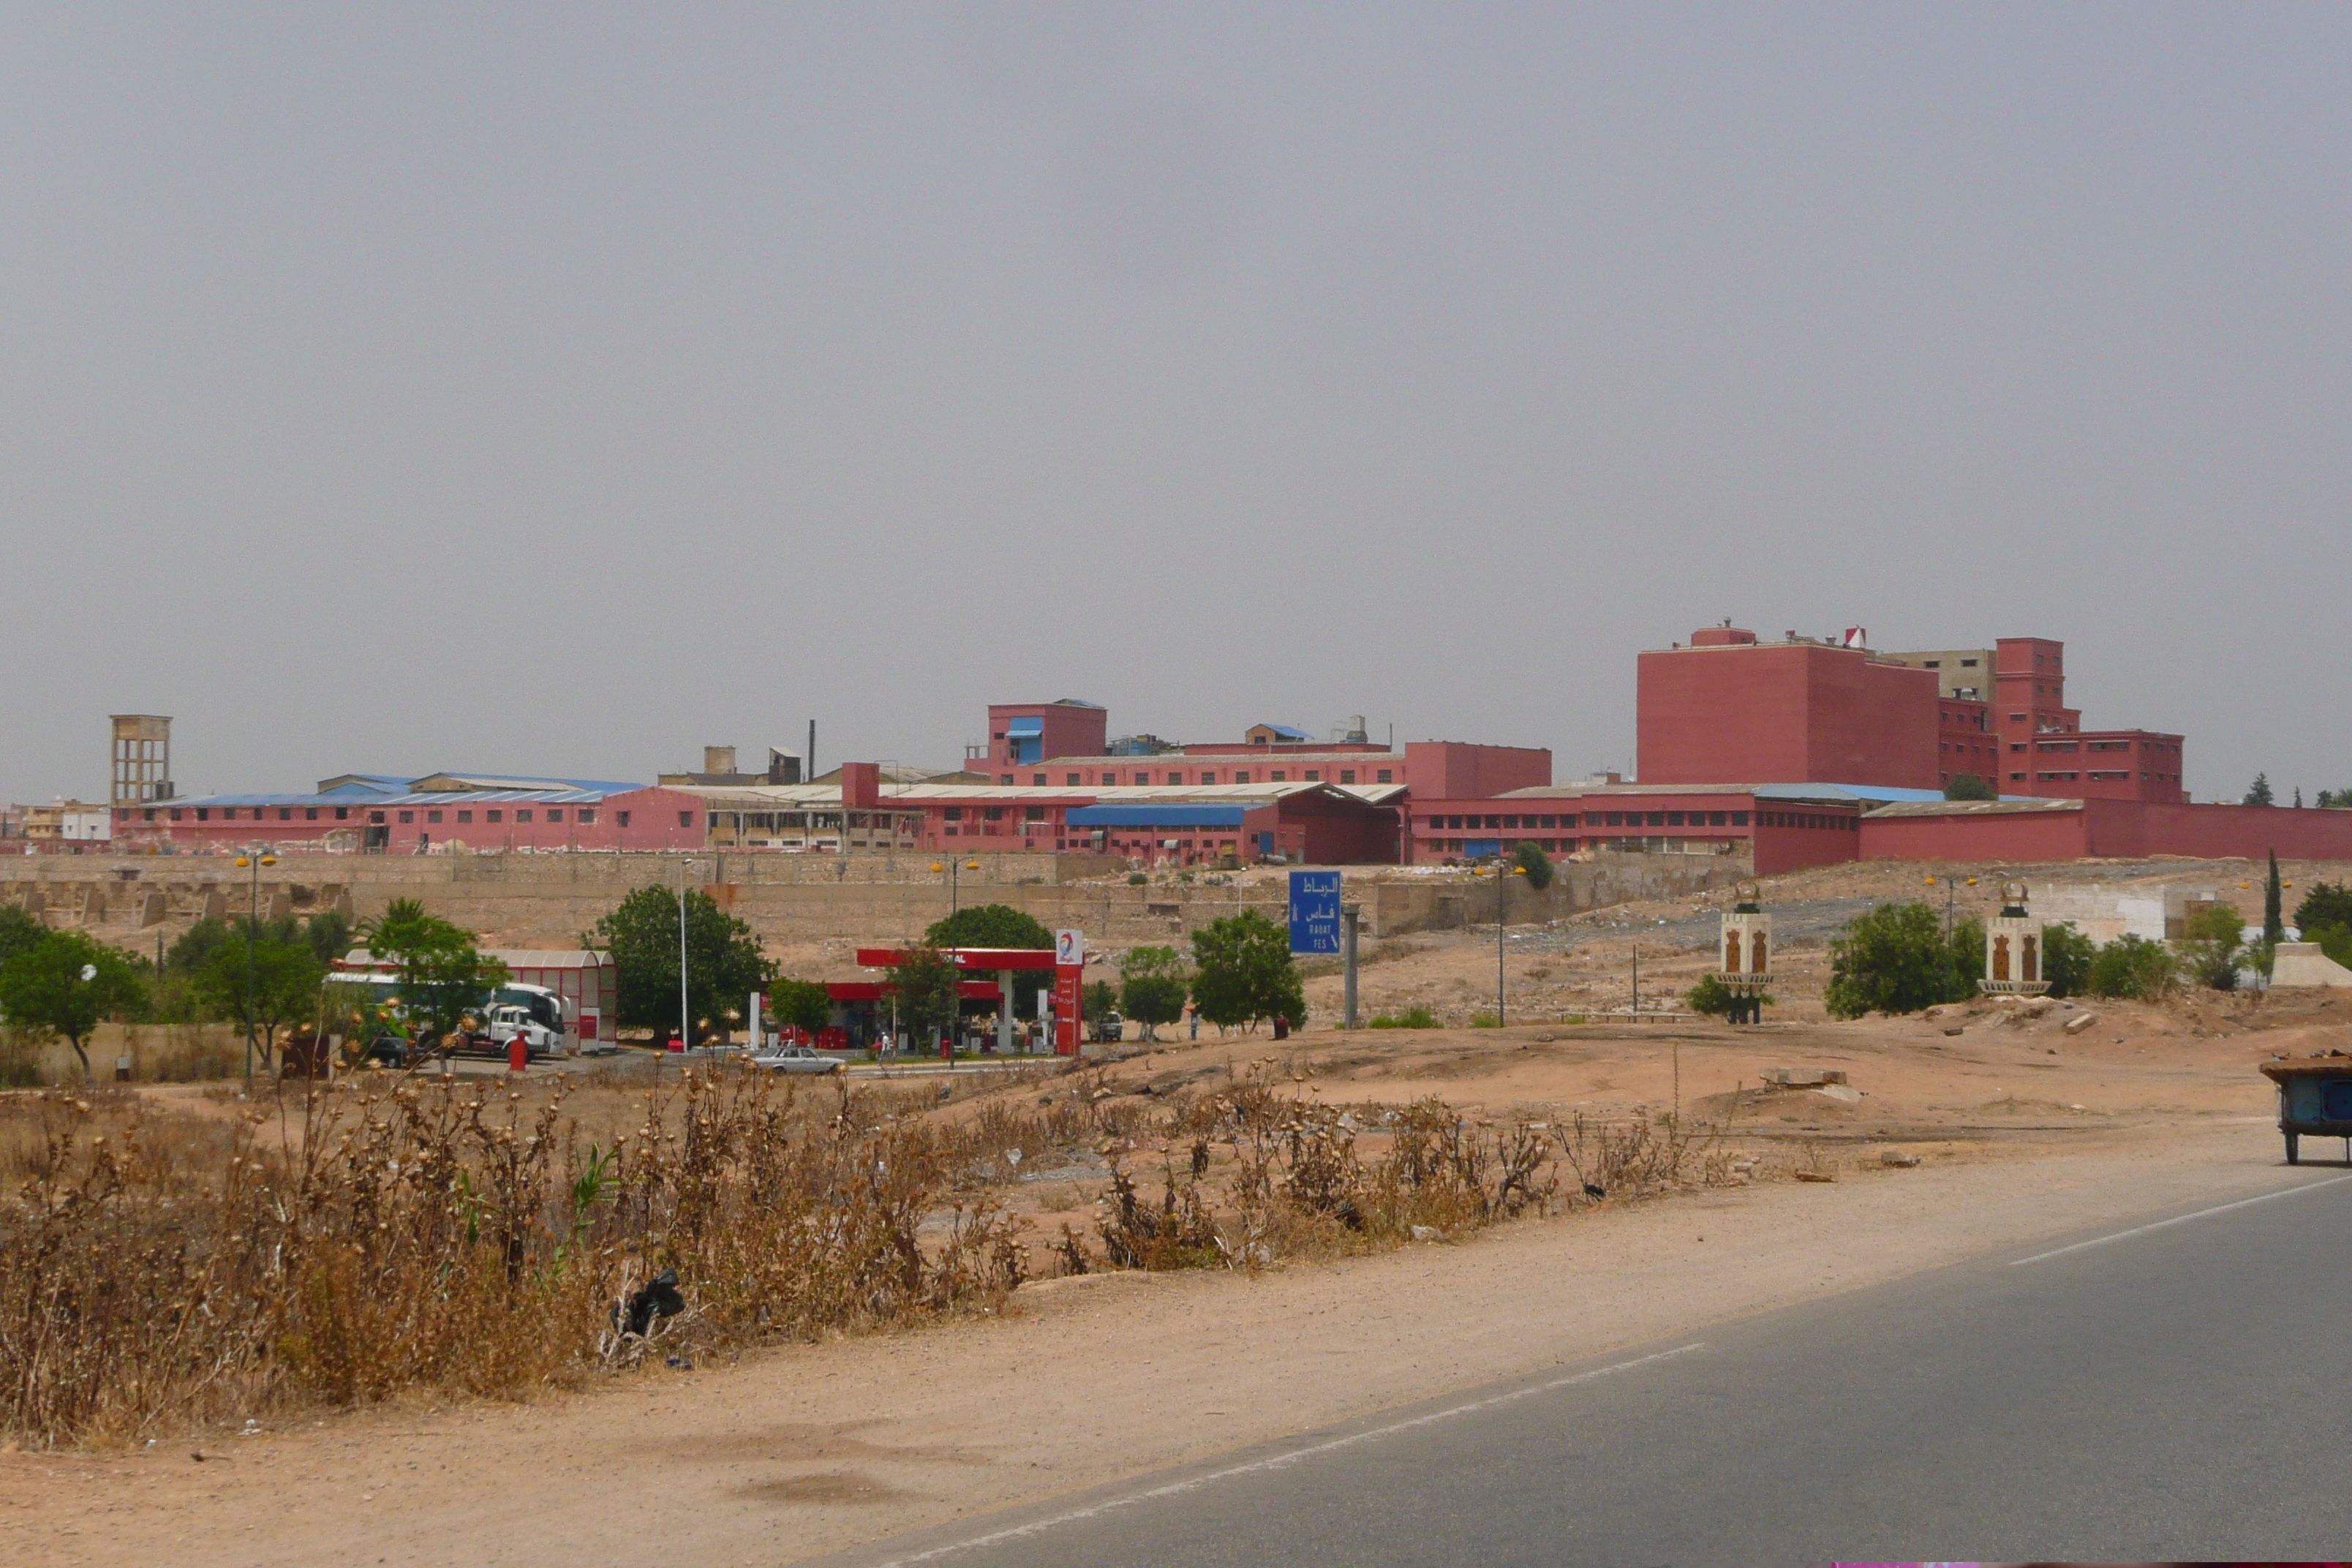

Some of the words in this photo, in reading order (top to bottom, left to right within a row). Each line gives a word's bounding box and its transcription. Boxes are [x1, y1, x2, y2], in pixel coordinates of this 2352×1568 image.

[1303, 877, 1338, 897] الرباط
[1305, 903, 1335, 921] فاس
[1309, 924, 1331, 934] RABAT
[1313, 938, 1327, 949] FES
